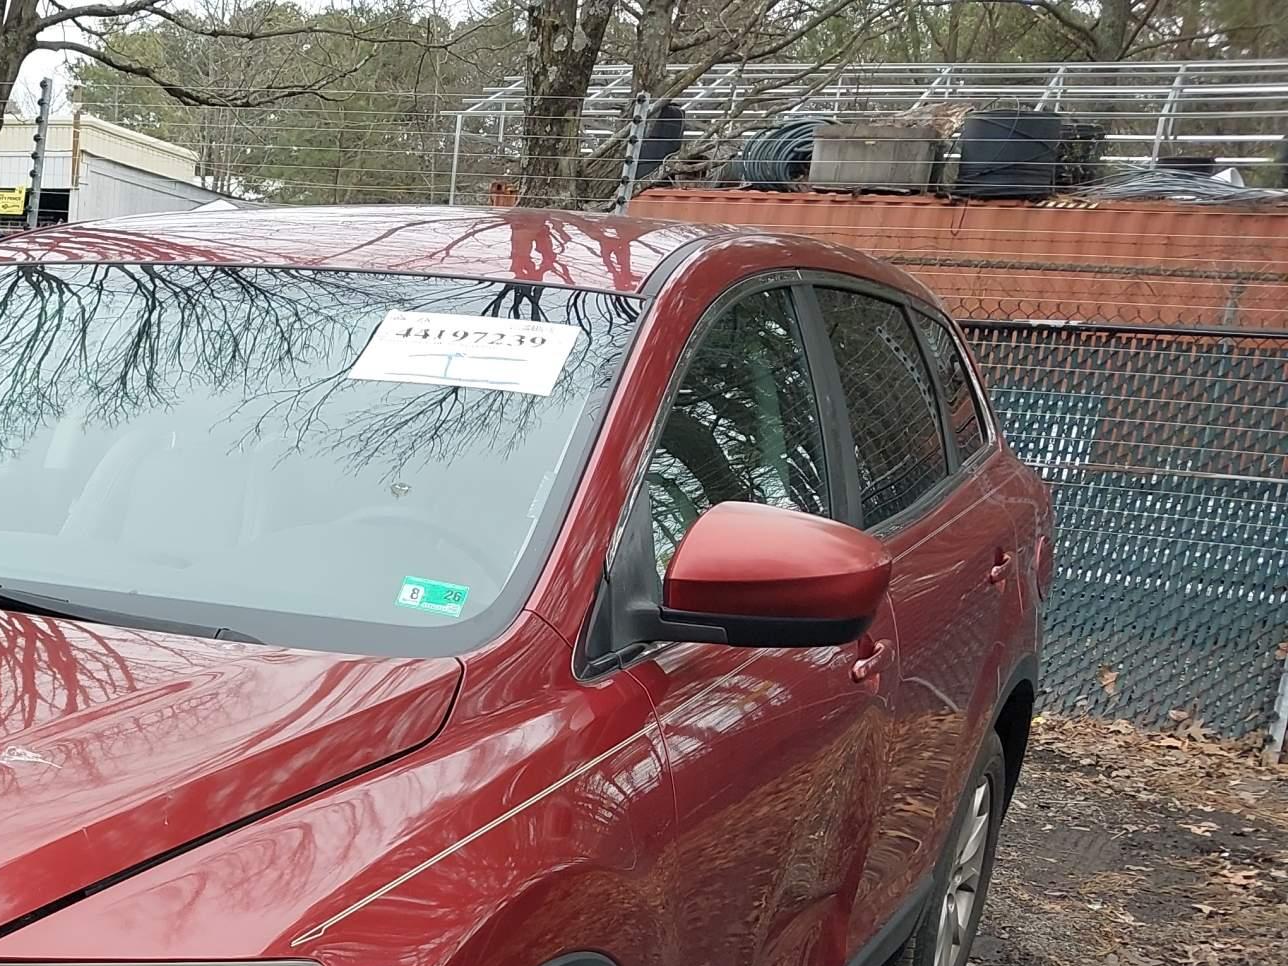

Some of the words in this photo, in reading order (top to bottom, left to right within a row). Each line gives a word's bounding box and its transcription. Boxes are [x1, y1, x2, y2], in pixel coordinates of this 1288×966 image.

[395, 327, 547, 348] 44197239
[410, 587, 420, 600] 8
[444, 589, 463, 602] 26
